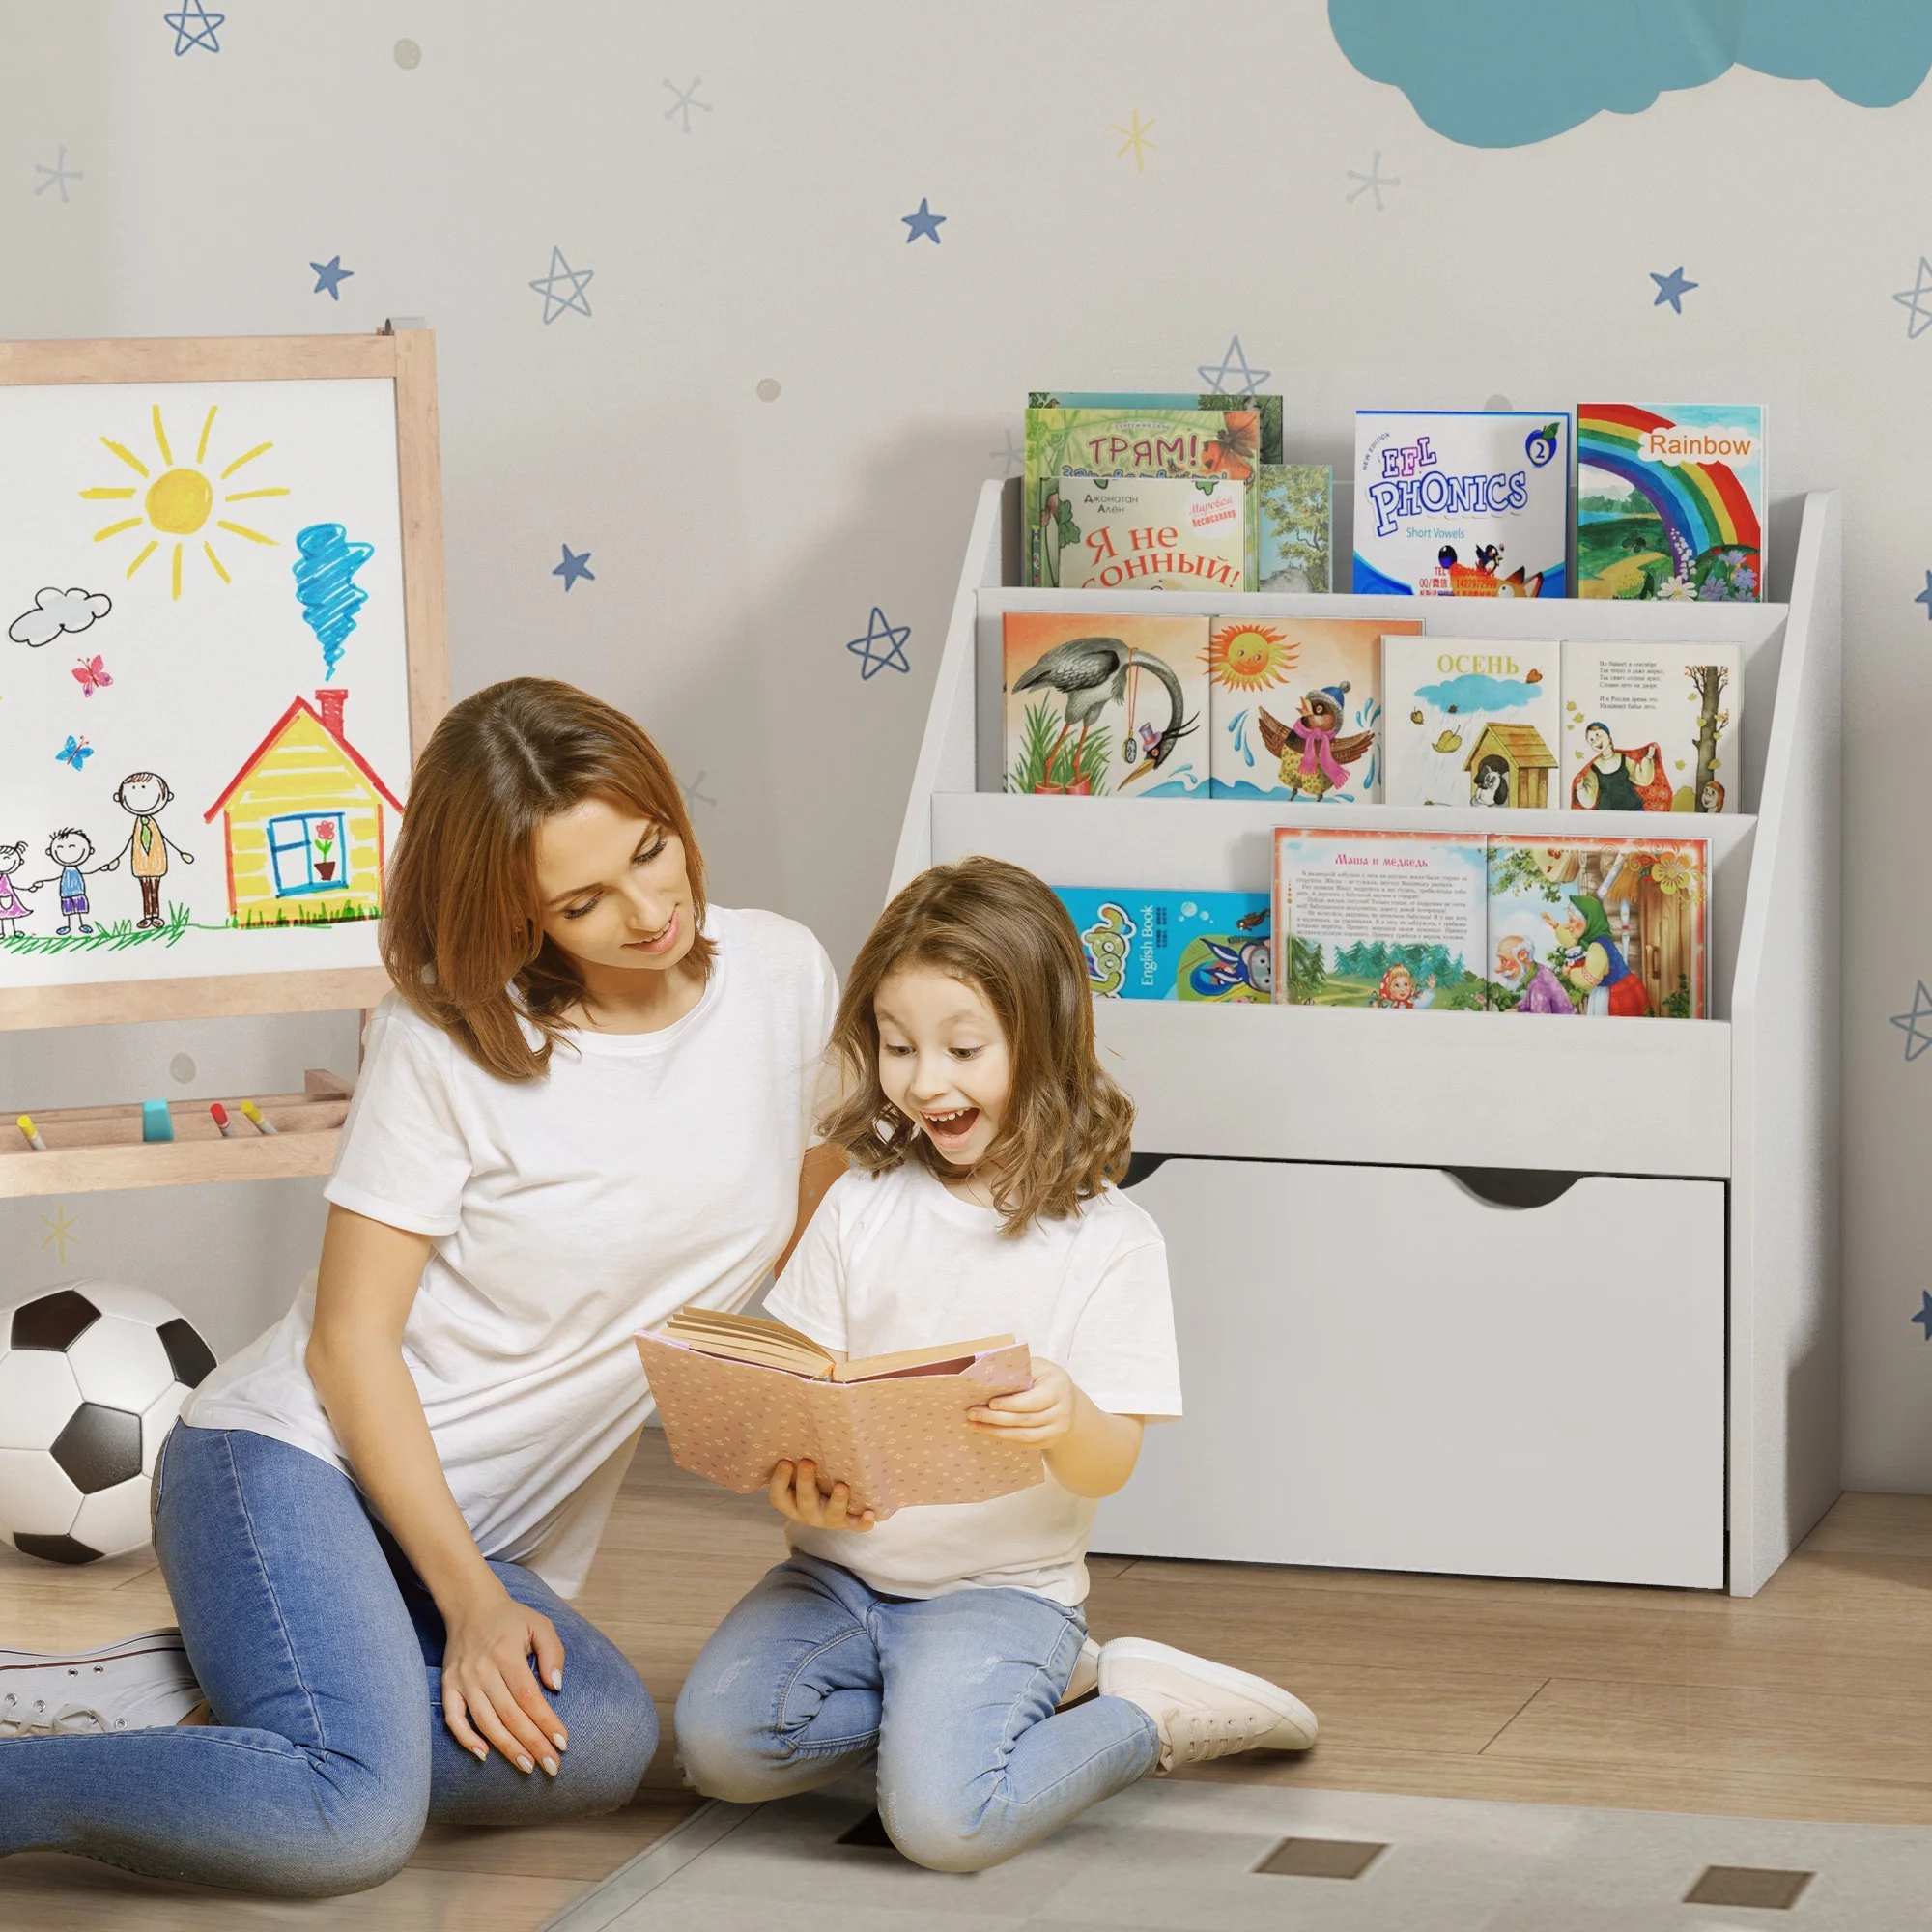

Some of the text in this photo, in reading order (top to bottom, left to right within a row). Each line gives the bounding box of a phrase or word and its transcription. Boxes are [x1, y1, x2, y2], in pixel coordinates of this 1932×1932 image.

[1088, 434, 1198, 467] ТРЯМ!
[1362, 431, 1390, 471] NEW EDITION
[1381, 437, 1437, 479] EFL
[1535, 441, 1546, 459] 2
[1650, 434, 1751, 455] Rainbow
[1084, 494, 1139, 505] Джонатан
[1369, 470, 1528, 537] PHONICS
[1085, 526, 1178, 566] Я не
[1406, 526, 1464, 539] Short Vowels
[1437, 653, 1520, 674] ОСЕНЬ
[1335, 854, 1429, 868] Маша и медведь
[1141, 905, 1158, 986] English Book
